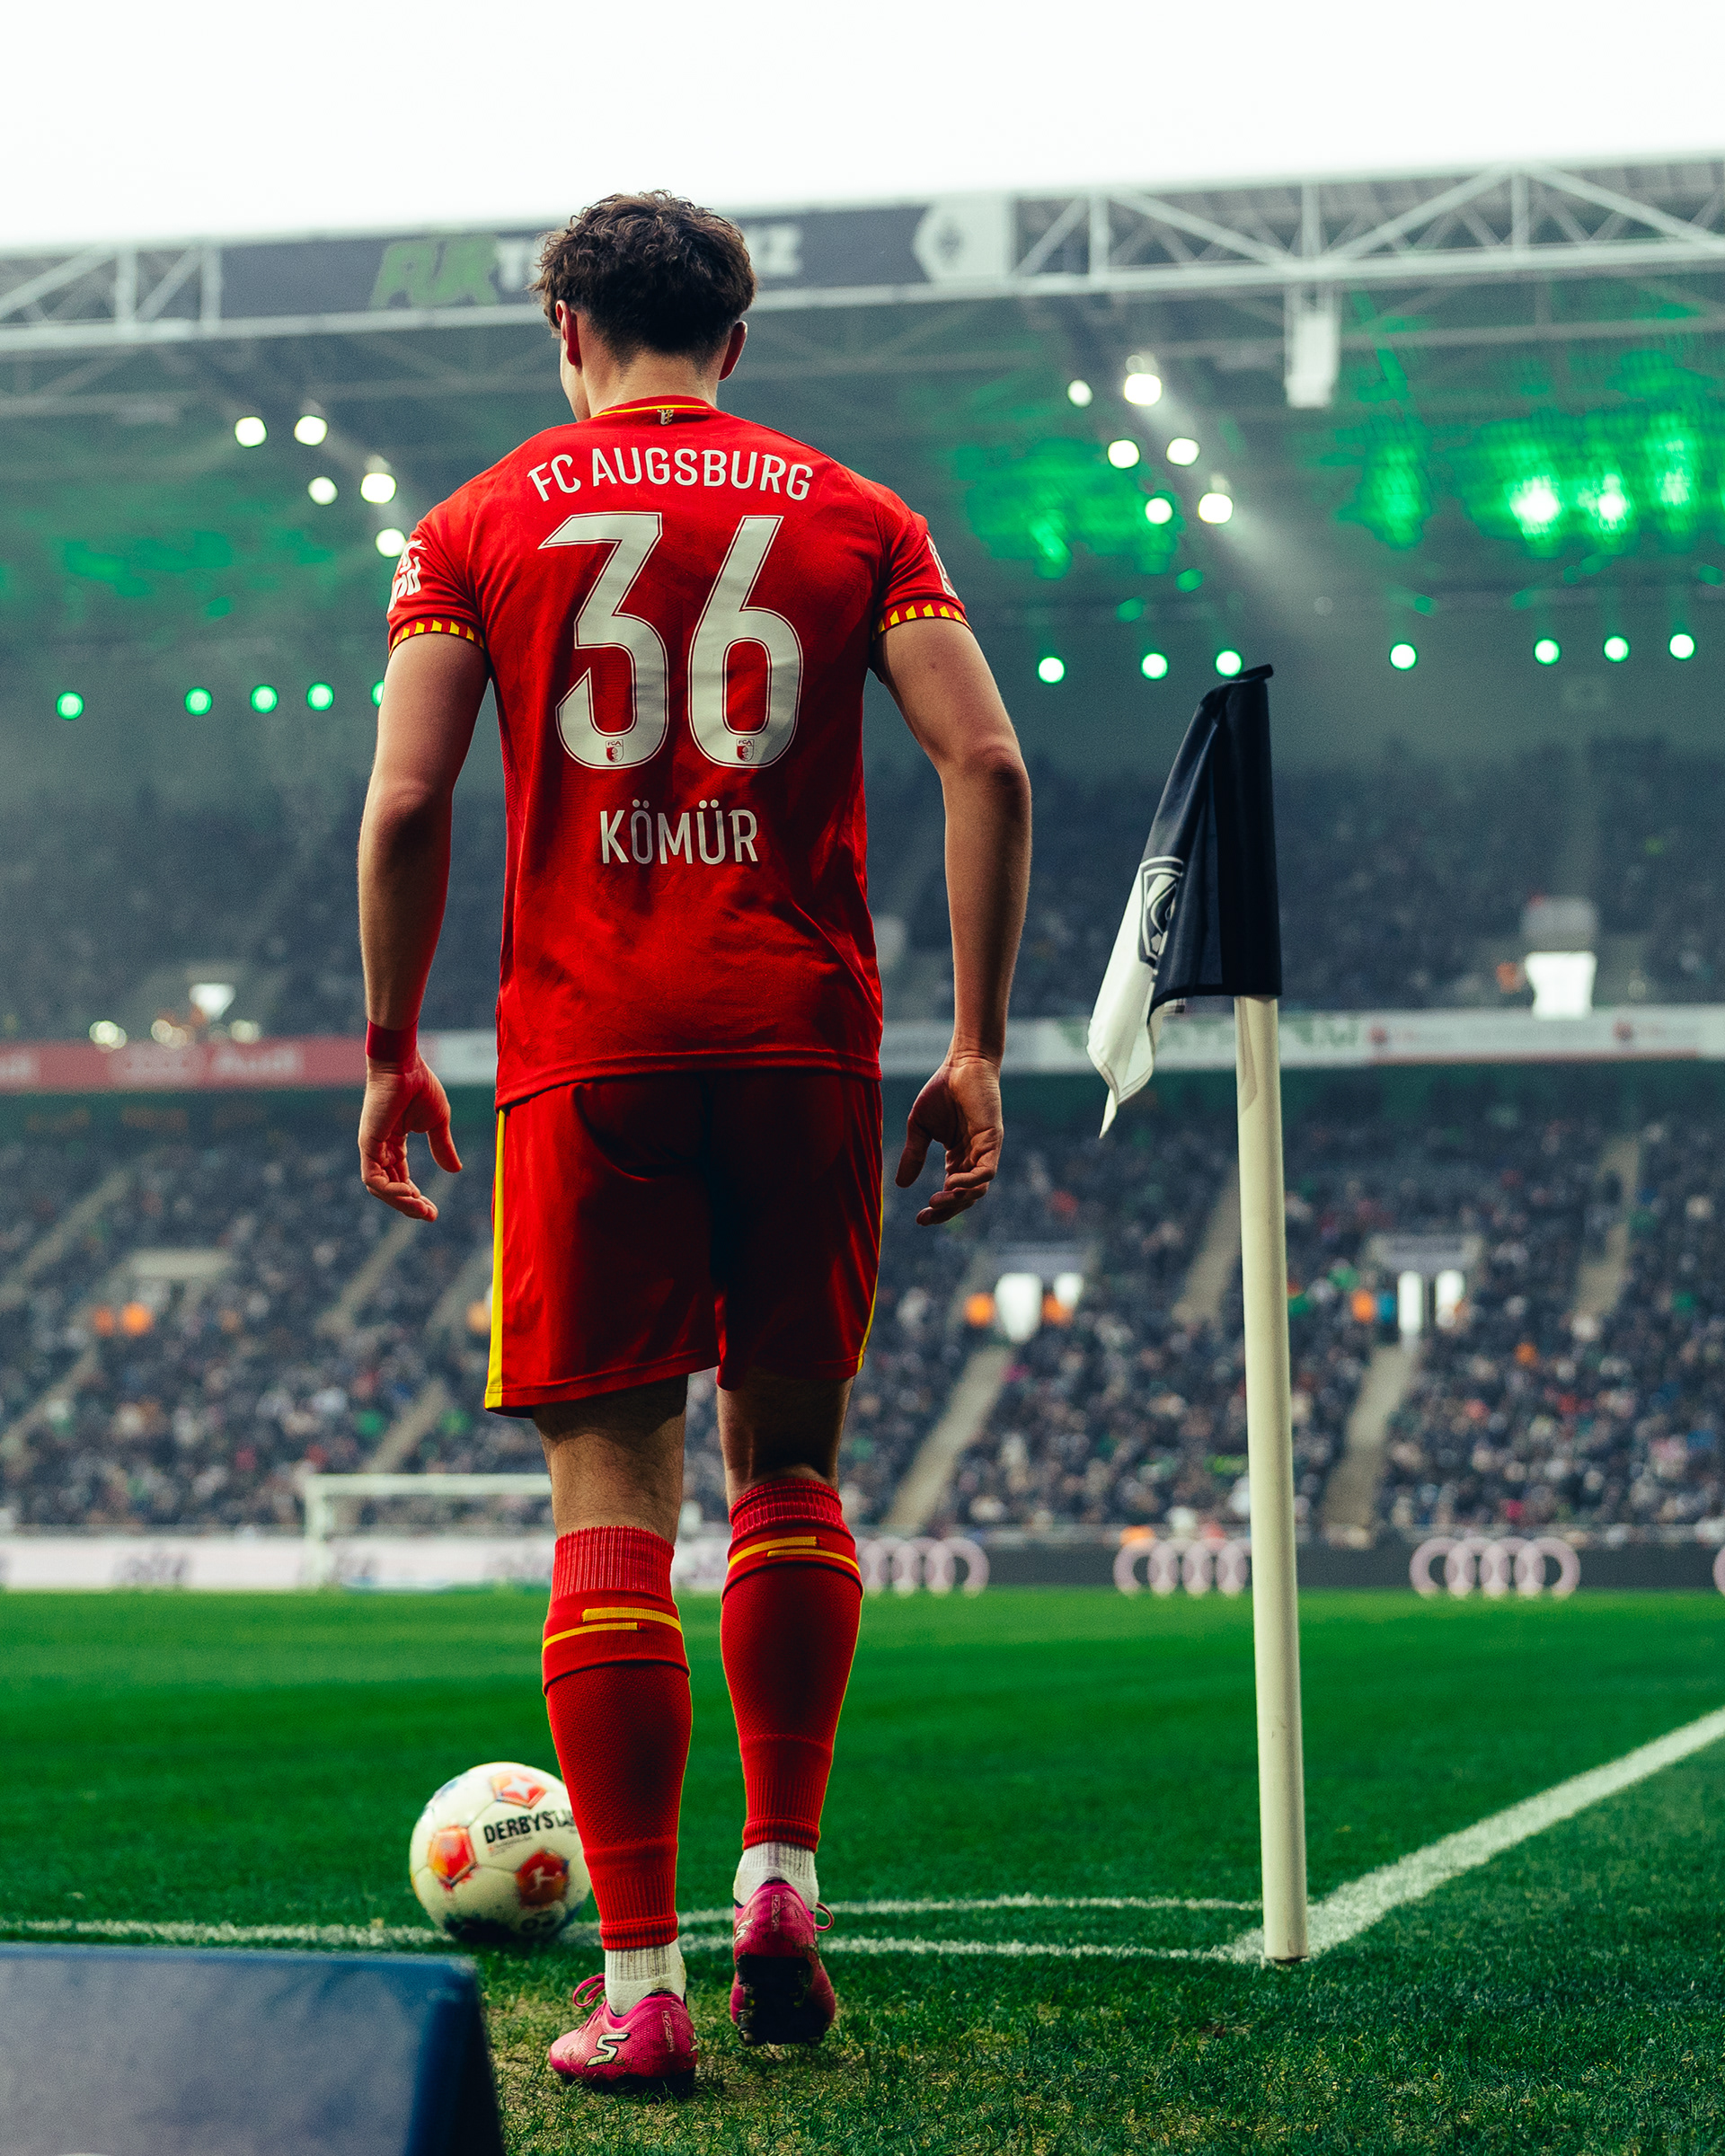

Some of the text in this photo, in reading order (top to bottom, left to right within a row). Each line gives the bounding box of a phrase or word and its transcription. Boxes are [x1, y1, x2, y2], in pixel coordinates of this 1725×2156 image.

[527, 446, 814, 502] FC AUGSBURG
[537, 510, 804, 770] 36
[599, 799, 758, 865] KÖMÜR
